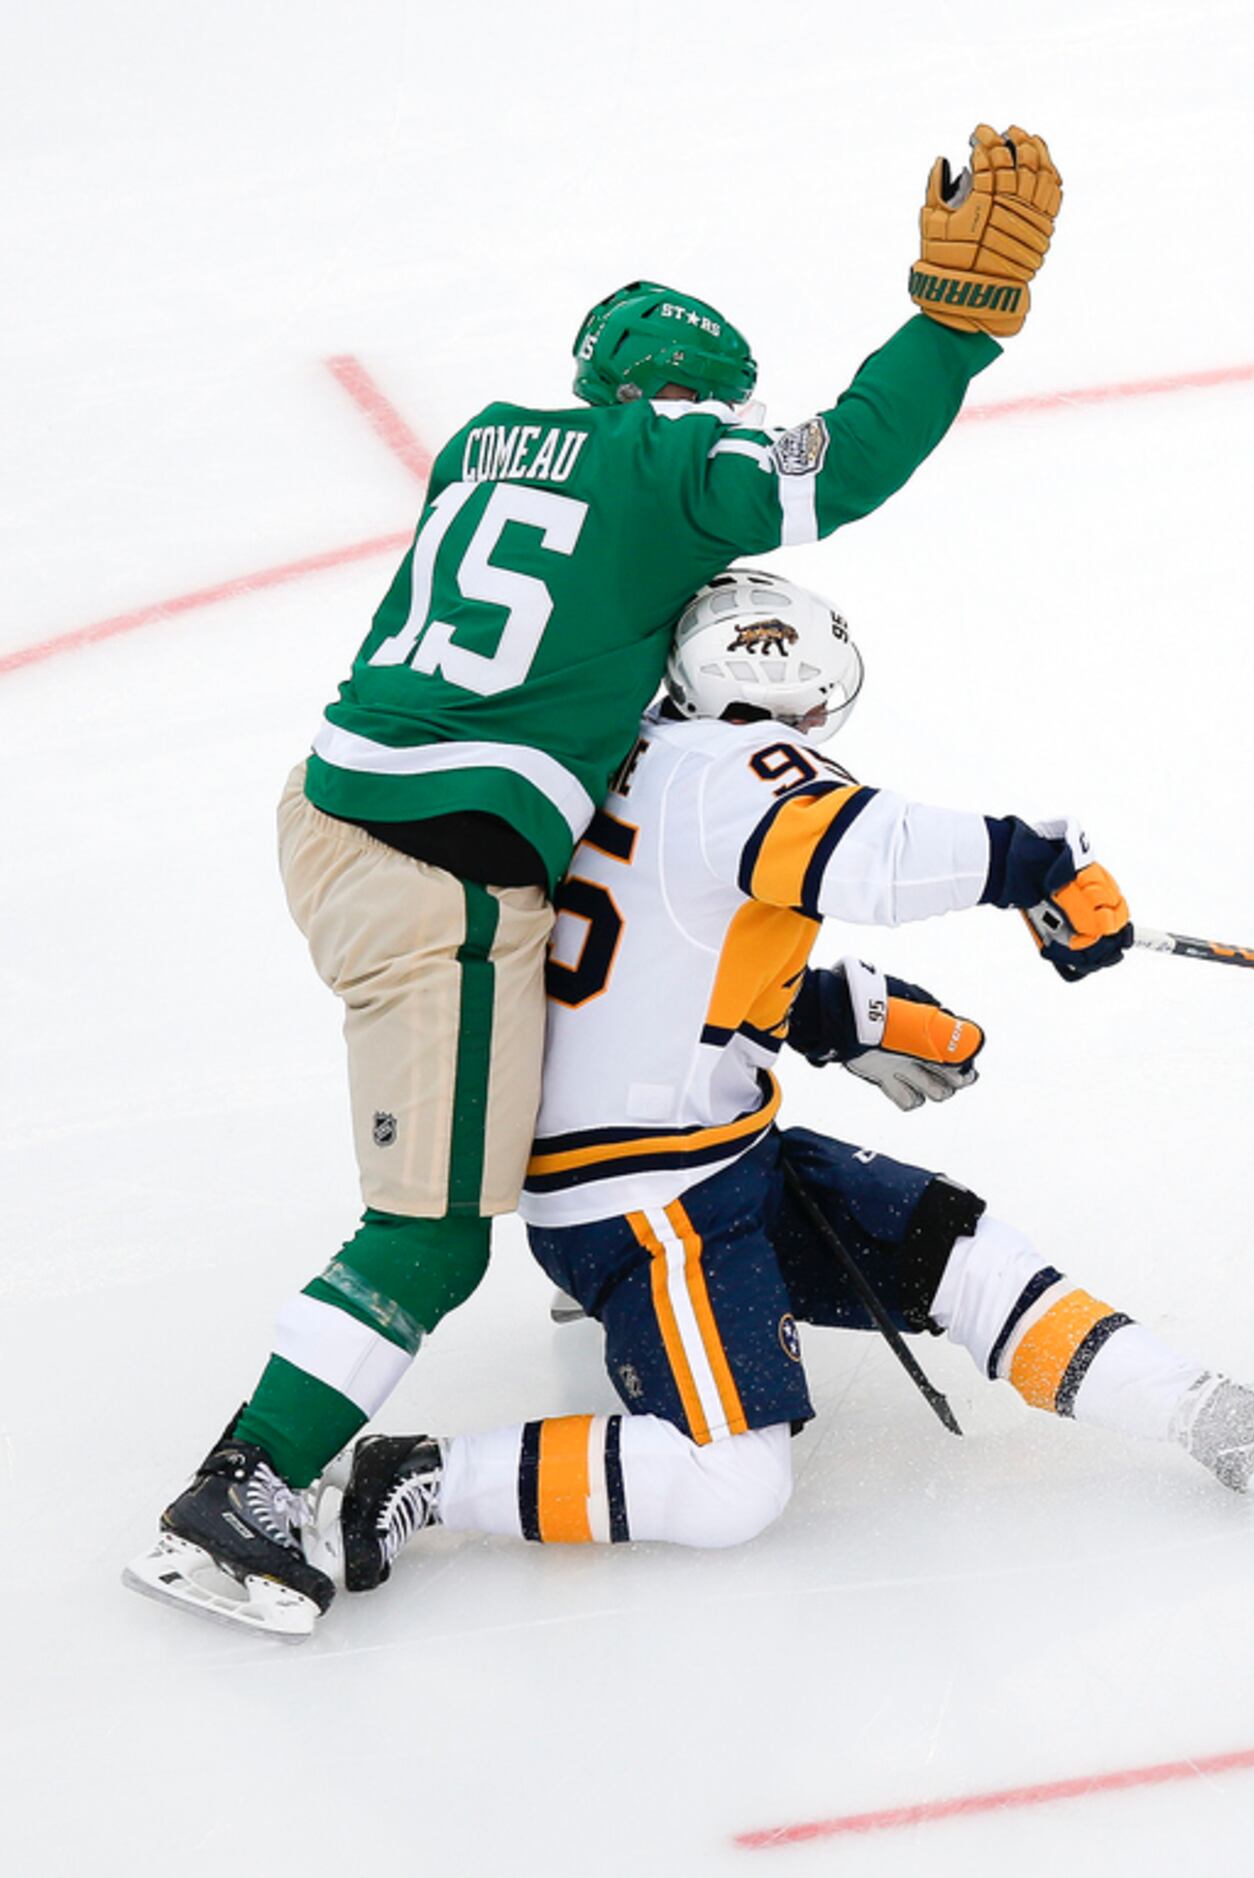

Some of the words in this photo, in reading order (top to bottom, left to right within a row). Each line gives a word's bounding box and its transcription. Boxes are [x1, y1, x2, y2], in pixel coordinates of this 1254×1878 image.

[462, 425, 589, 483] COMEAU
[367, 481, 589, 697] 15
[831, 609, 848, 643] 95
[868, 999, 886, 1024] 95
